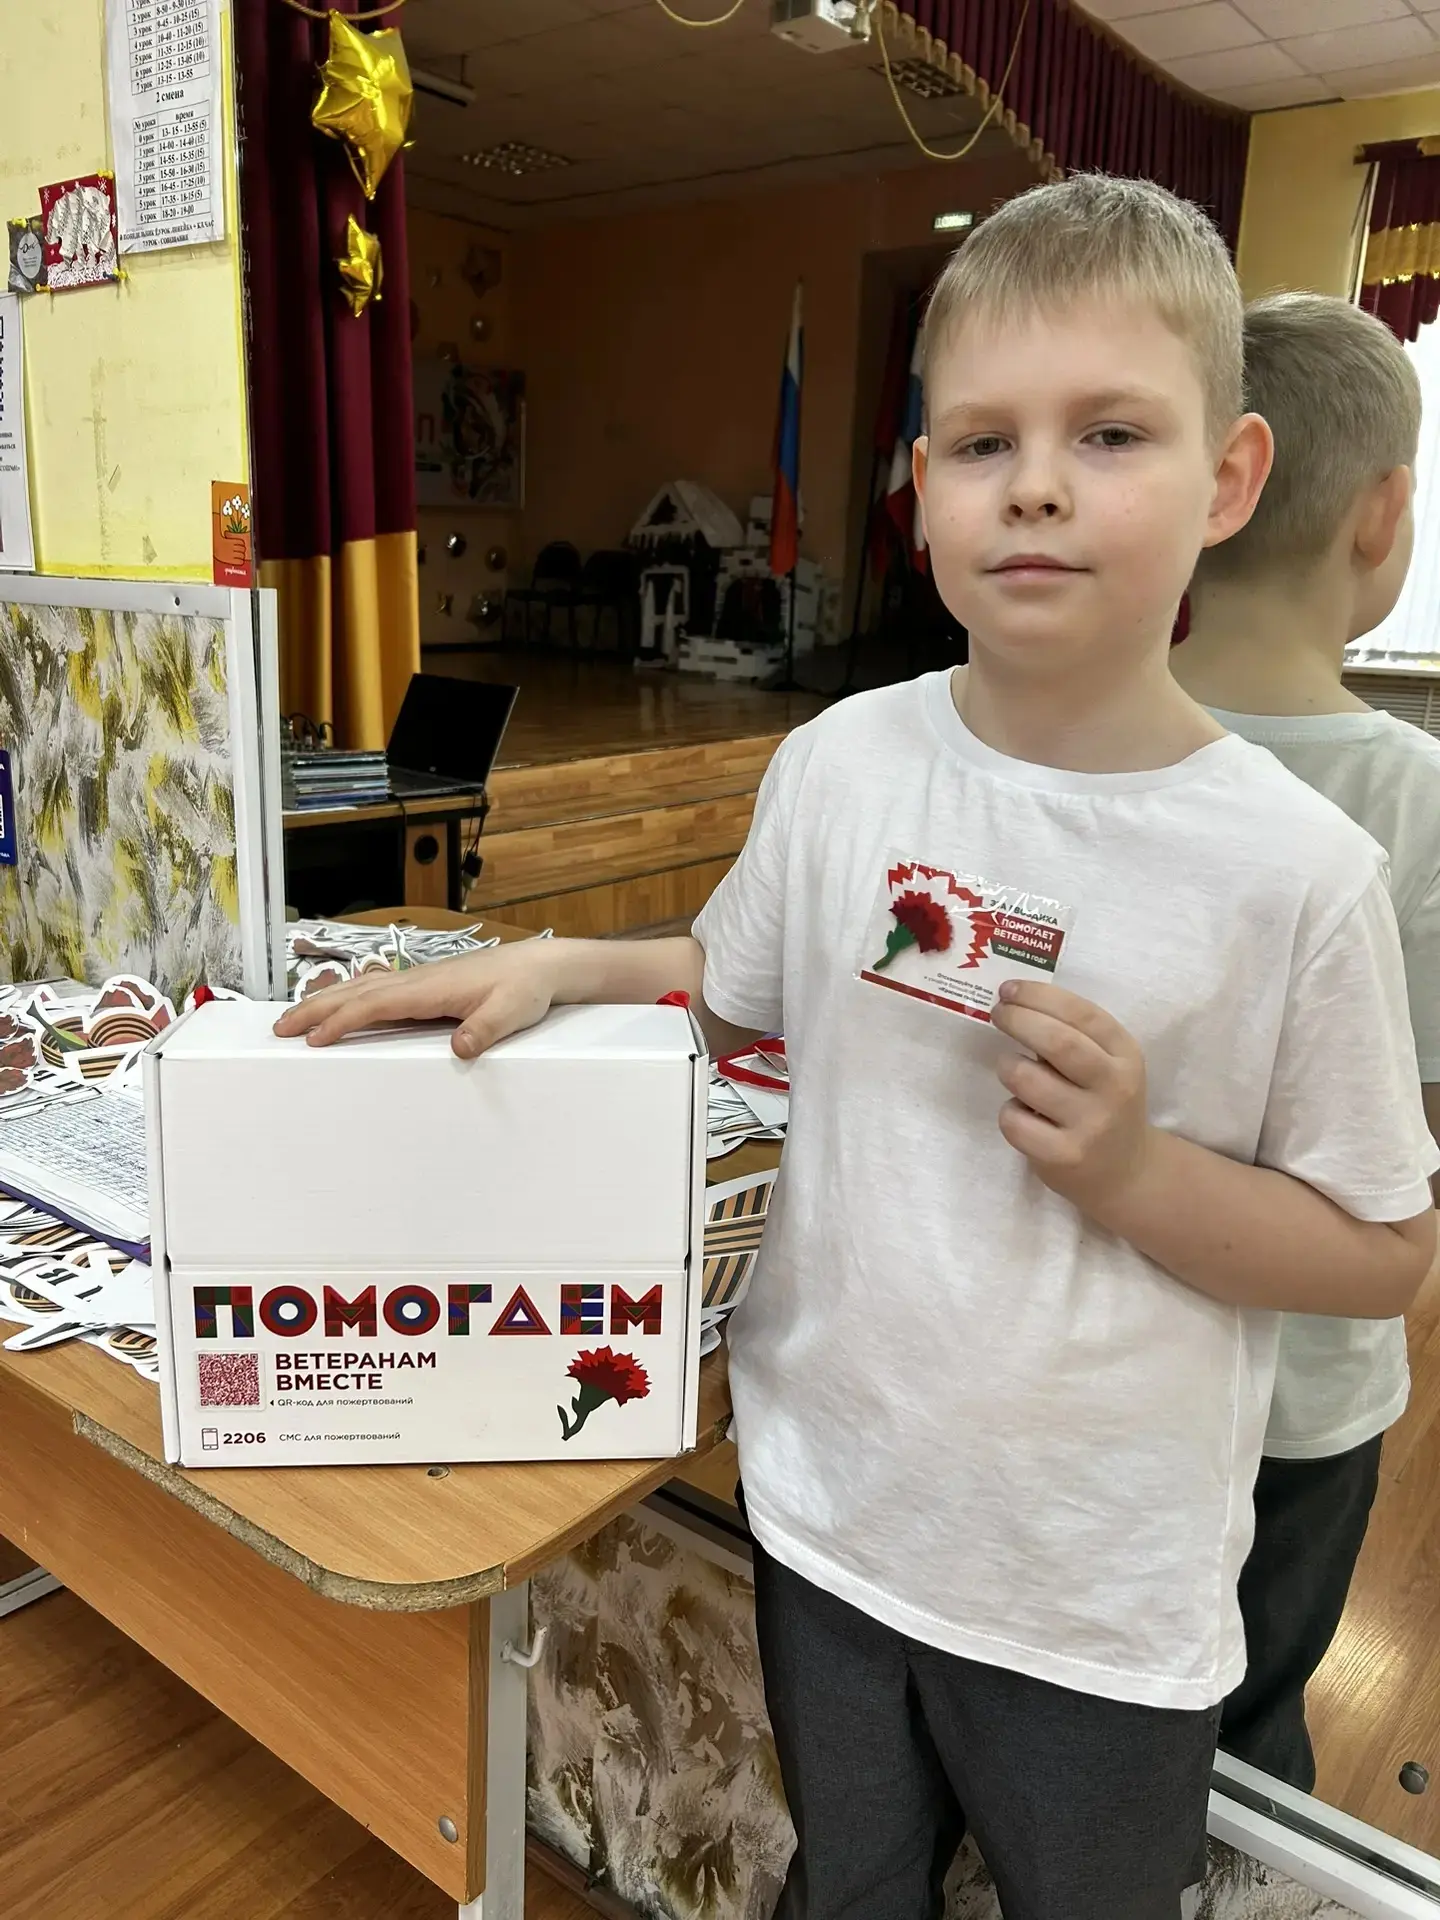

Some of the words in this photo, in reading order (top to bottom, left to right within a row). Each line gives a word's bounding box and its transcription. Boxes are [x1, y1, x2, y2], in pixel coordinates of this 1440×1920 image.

[132, 13, 136, 22] 2
[137, 12, 152, 24] урок
[134, 27, 138, 36] 3
[139, 26, 152, 37] урок
[189, 8, 200, 19] (15)
[139, 39, 152, 50] урок
[193, 22, 204, 33] (15)
[135, 55, 138, 63] 5
[139, 53, 152, 64] урок
[158, 45, 172, 57] 11-35
[177, 39, 192, 52] 12-15
[139, 66, 152, 78] урок
[158, 59, 172, 71] 12-25
[140, 81, 153, 92] урок
[158, 73, 172, 85] 13-15
[178, 69, 194, 80] 13-55
[156, 92, 160, 102] 2
[162, 90, 184, 101] смена
[142, 118, 156, 131] урока
[176, 111, 194, 122] время
[143, 133, 154, 145] урок
[184, 122, 198, 133] 13-55
[143, 147, 154, 158] урок
[160, 140, 174, 151] 14-00
[195, 134, 205, 144] (15)
[143, 160, 155, 171] урок
[160, 154, 175, 165] 14-55
[180, 151, 194, 162] 15-35
[195, 148, 205, 159] (15)
[143, 173, 155, 184] урок
[160, 168, 175, 179] 15-50
[195, 162, 205, 173] (15)
[142, 186, 156, 197] урок
[161, 181, 176, 191] 16-45
[180, 178, 194, 188] 17-25
[143, 200, 156, 210] урок
[162, 195, 176, 205] 17-35
[180, 191, 194, 202] 18-15
[144, 213, 157, 223] урок
[162, 208, 176, 218] 18-20
[181, 205, 194, 215] 19-00
[990, 900, 1006, 910] ЭА
[1002, 918, 1056, 940] ПОМОГАЕТ
[994, 927, 1052, 952] ВЕТЕРАНАМ
[1009, 948, 1025, 958] ДНЕЙ
[1031, 955, 1048, 964] ГОДУ
[193, 1284, 662, 1338] ПОМОГАЕМ
[276, 1352, 436, 1370] ВЕТЕРАНАМ
[276, 1373, 382, 1390] ВМЕСТЕ
[278, 1399, 314, 1407] QR-код
[316, 1399, 334, 1407] для
[336, 1397, 413, 1407] пожертвований
[223, 1432, 266, 1445] 2206
[324, 1432, 400, 1441] пожертвований
